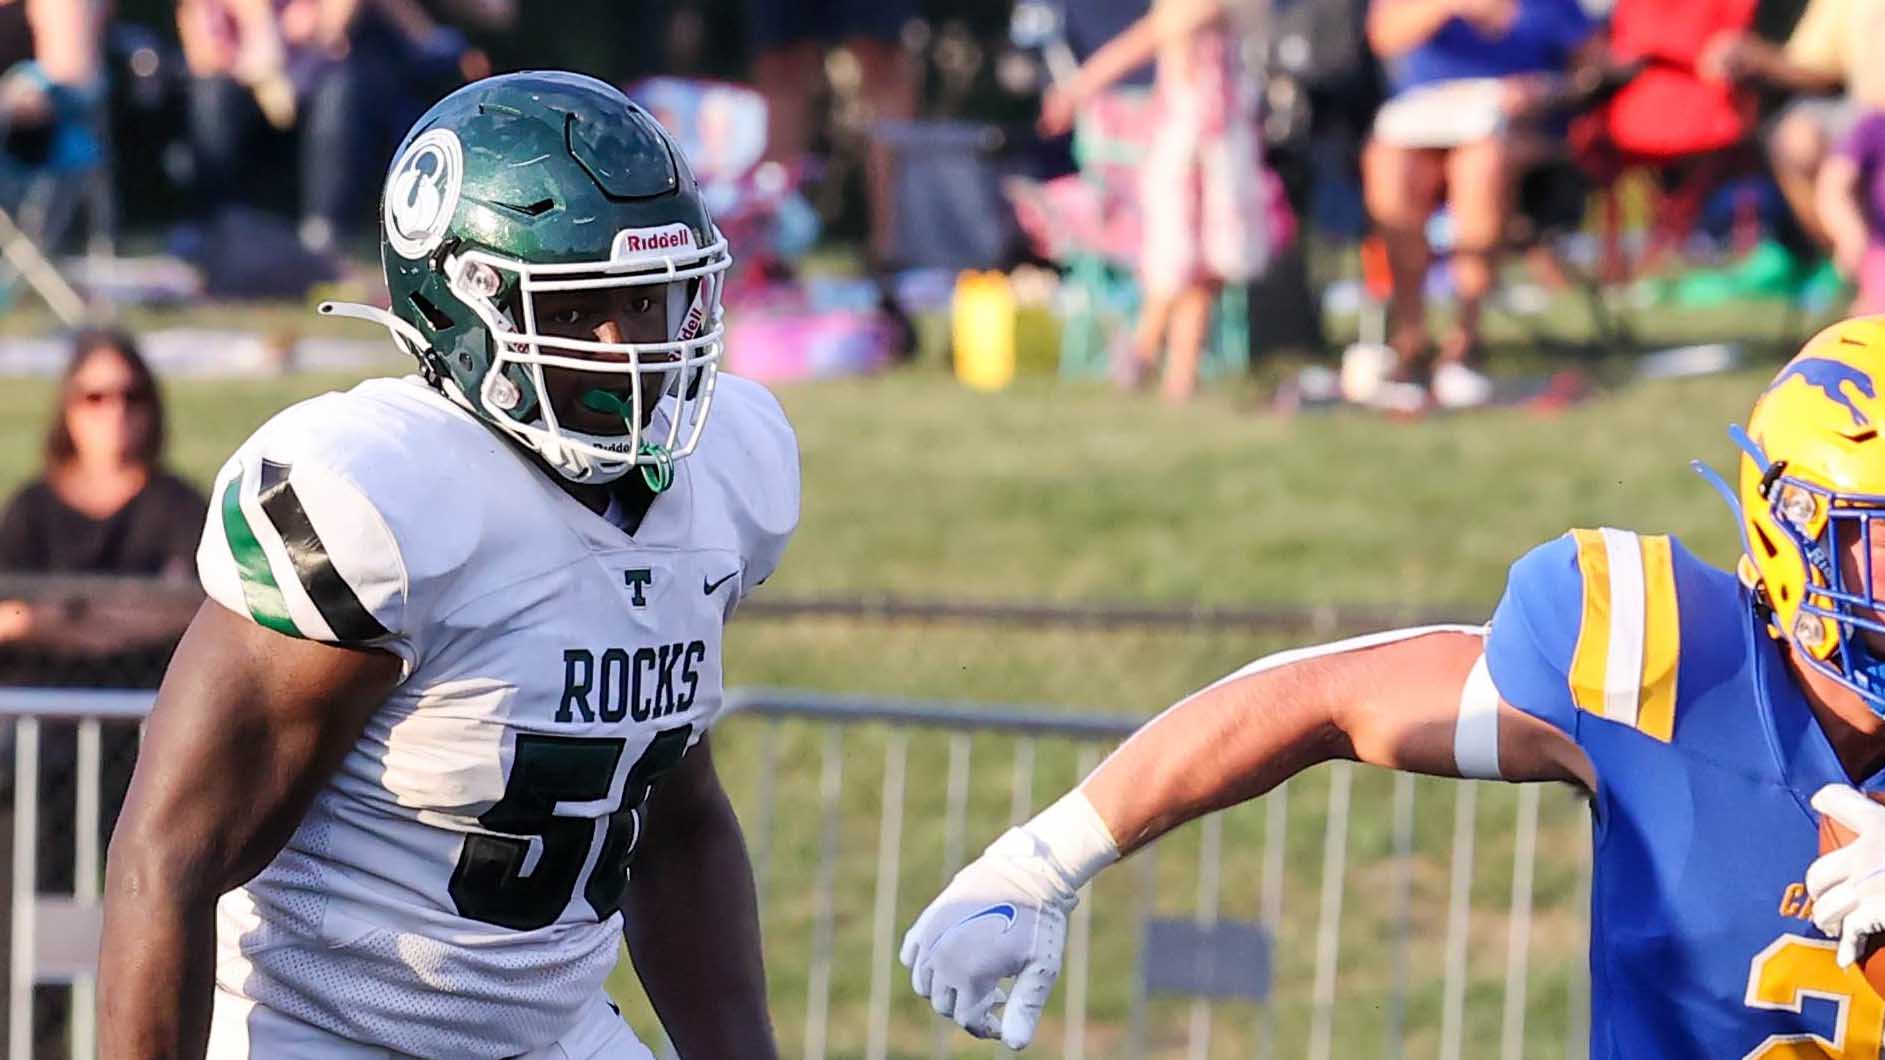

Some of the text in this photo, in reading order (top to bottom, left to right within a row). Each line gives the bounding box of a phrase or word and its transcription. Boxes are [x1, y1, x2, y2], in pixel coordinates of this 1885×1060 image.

[627, 229, 689, 252] Riddell
[624, 568, 652, 607] T
[554, 639, 706, 724] ROCKS
